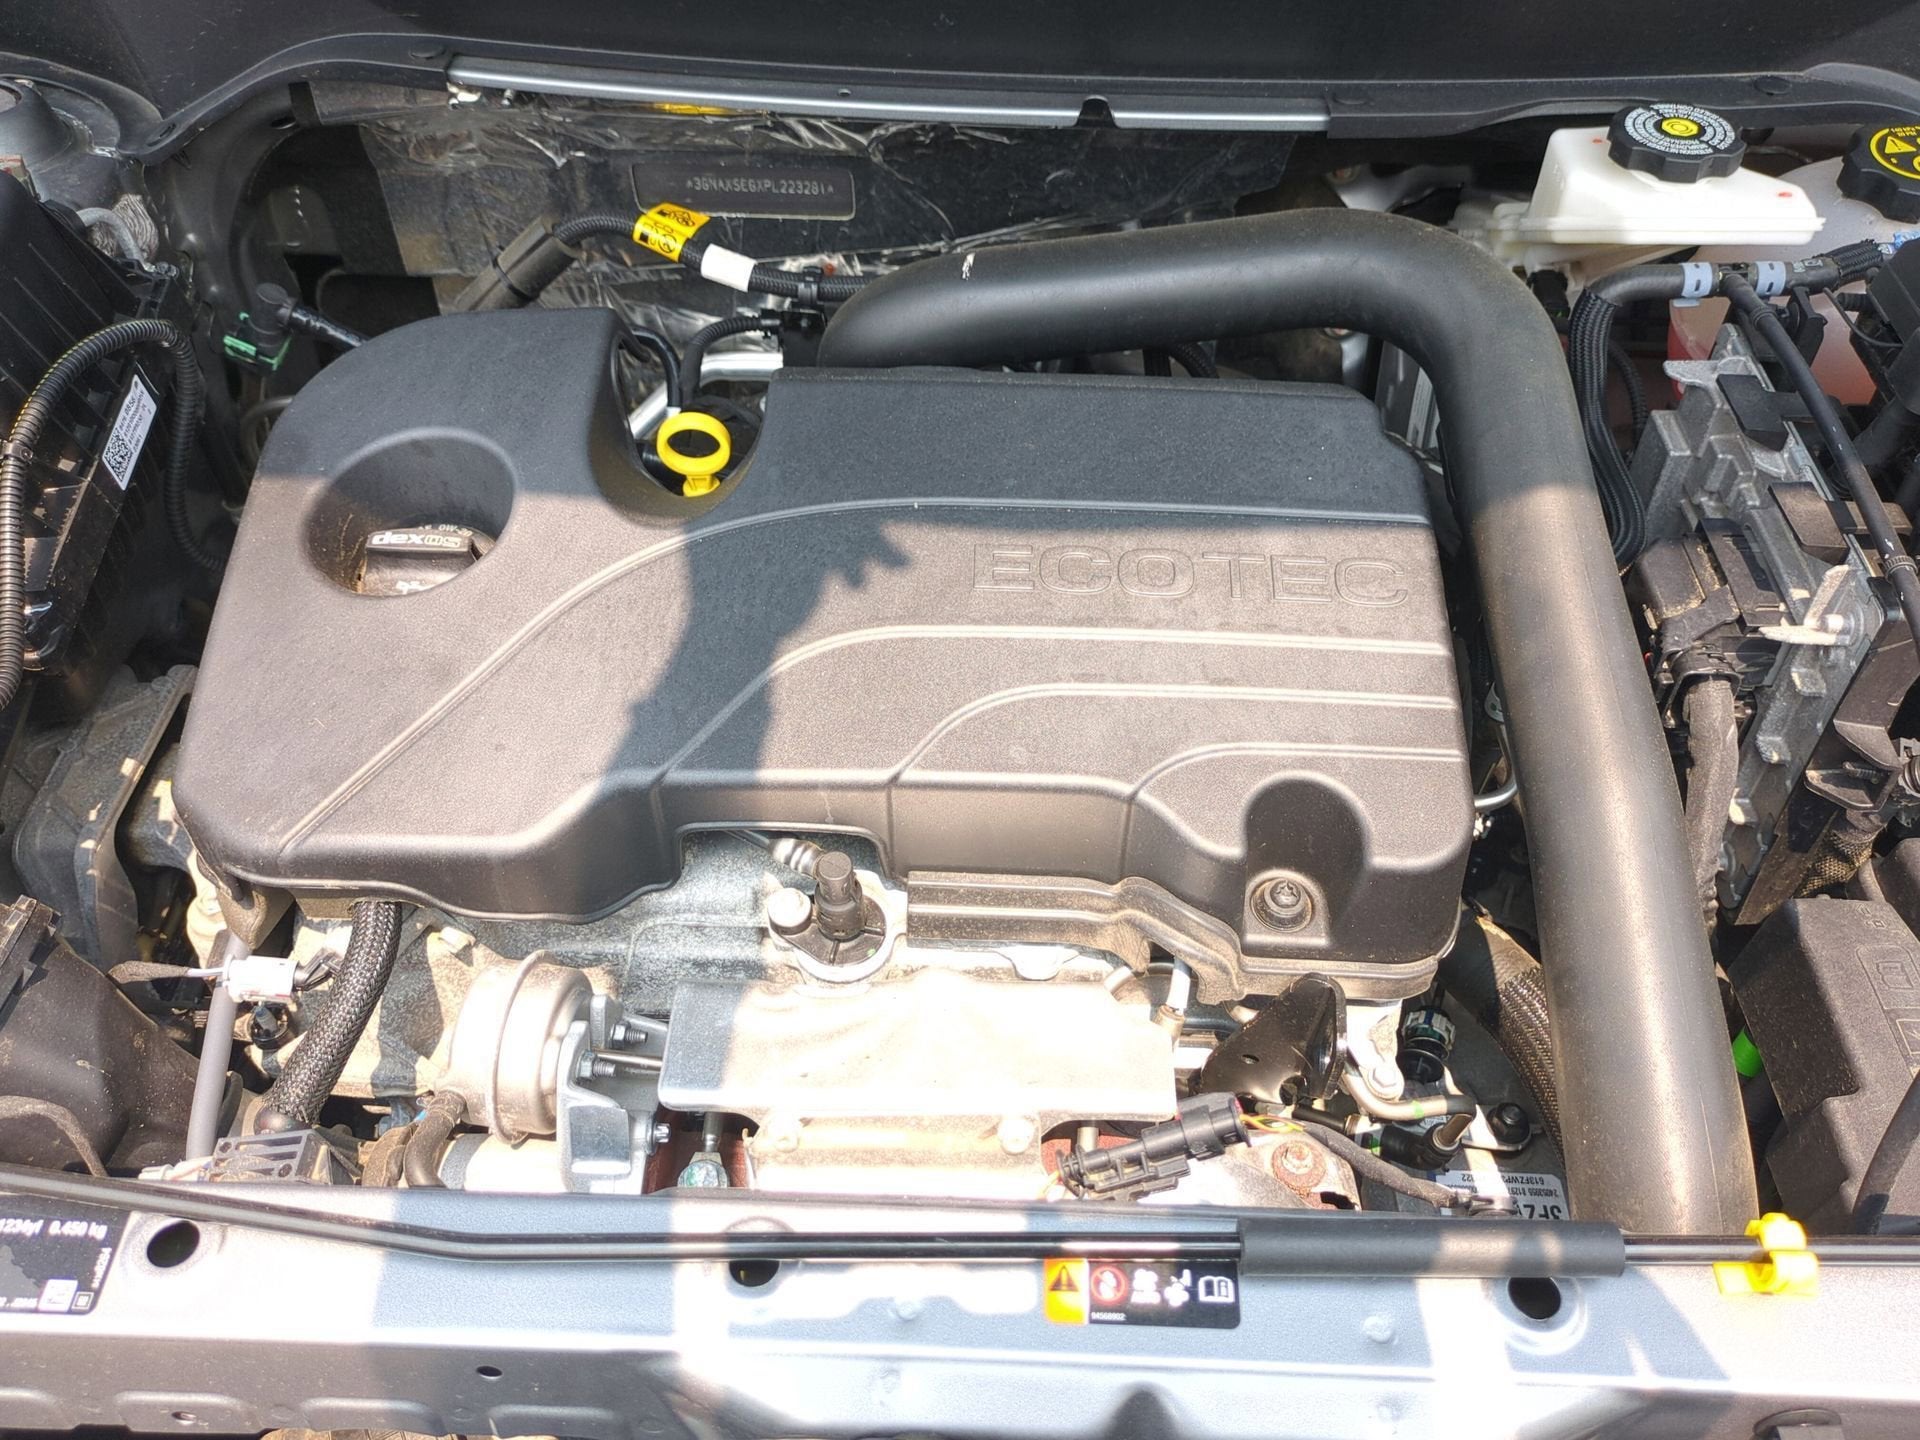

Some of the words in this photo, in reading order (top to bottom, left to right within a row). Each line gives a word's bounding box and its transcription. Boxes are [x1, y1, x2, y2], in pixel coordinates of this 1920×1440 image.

[372, 532, 462, 548] dexos
[972, 542, 1408, 608] ECOTEC
[87, 1221, 108, 1241] kg
